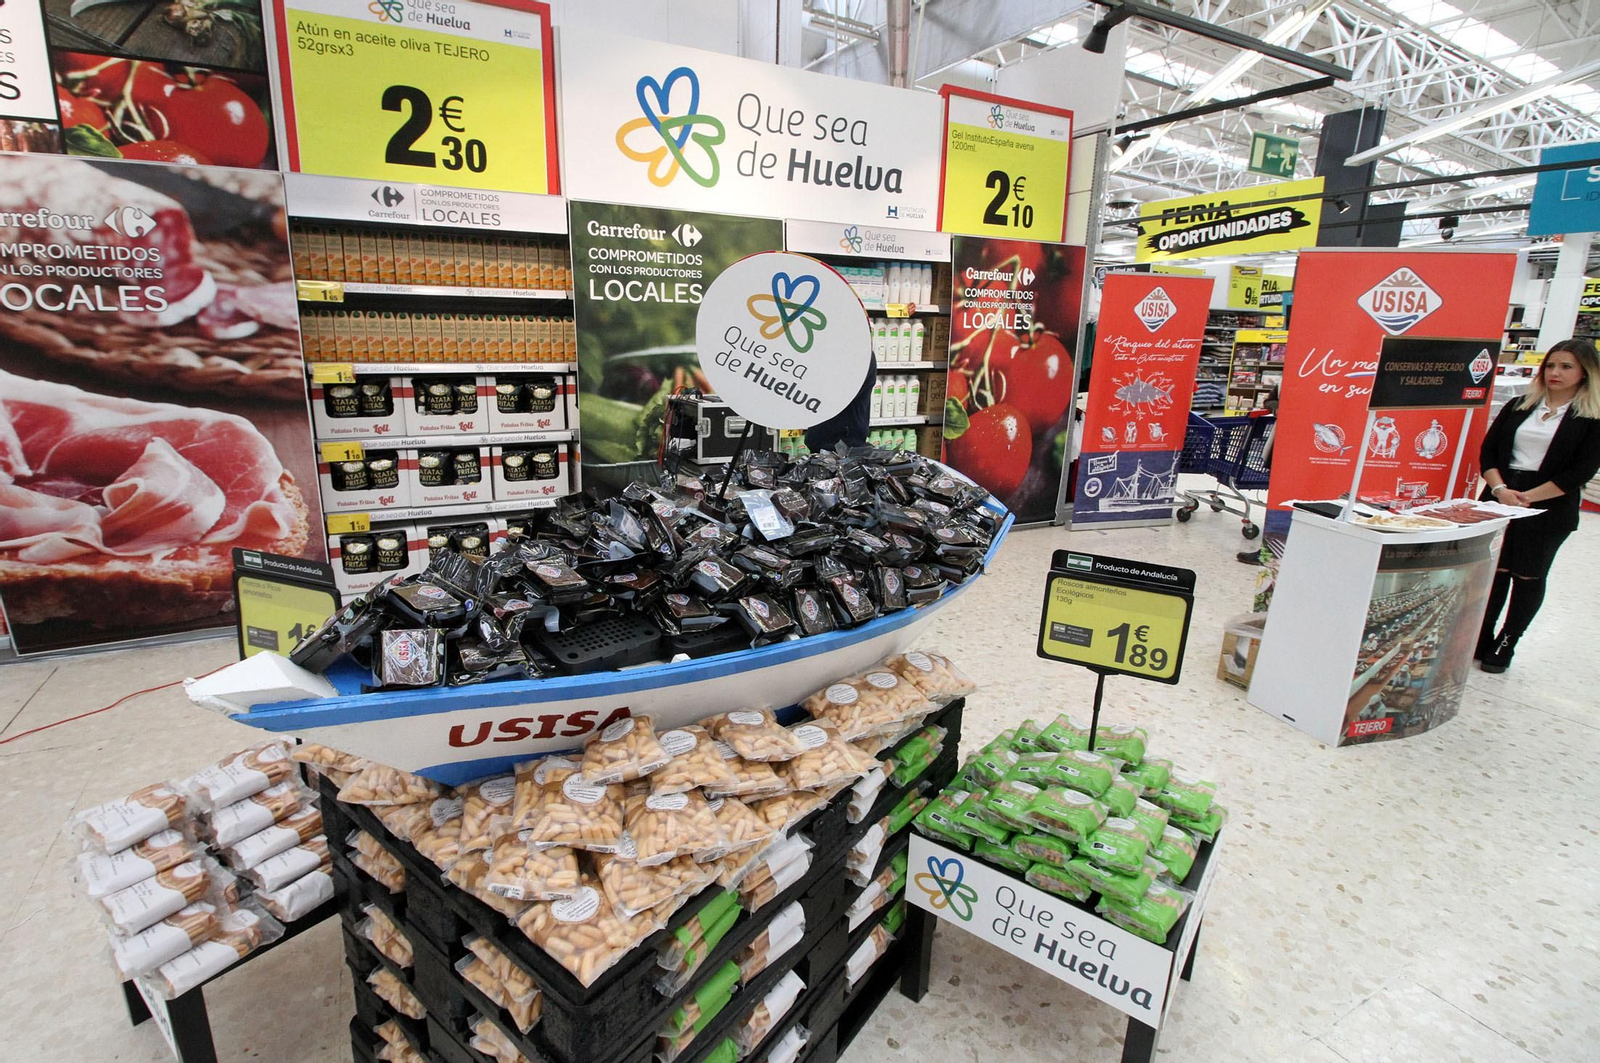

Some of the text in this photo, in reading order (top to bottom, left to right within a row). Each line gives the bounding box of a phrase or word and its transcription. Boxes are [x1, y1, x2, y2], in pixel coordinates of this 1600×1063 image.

[434, 1, 456, 14] sea
[407, 10, 471, 31] de Huelva
[296, 20, 490, 62] Atún en aceite oliva TEJERO
[297, 37, 354, 57] 52grsx3
[381, 84, 437, 169] 2
[441, 136, 487, 173] 30
[737, 93, 868, 147] Que sea
[1013, 121, 1035, 132] Huelva
[952, 130, 964, 140] Gel
[1015, 142, 1035, 151] avena
[737, 140, 903, 194] de Huelva
[368, 188, 500, 221] Carrefour COMPROMETIDOS
[983, 170, 1010, 226] 2
[1011, 204, 1034, 229] 10
[422, 208, 501, 227] LOCALES
[1161, 201, 1233, 227] FERIA
[587, 220, 667, 242] Carrefour
[864, 230, 896, 244] Que sea
[1159, 211, 1292, 251] OPORTUNIDADES
[588, 247, 703, 266] COMPROMETIDOS
[864, 242, 905, 254] de Huelva
[10, 265, 163, 279] LOS PRODUCTORES
[589, 264, 703, 279] CON LOS PRODUCTORES
[966, 267, 1014, 282] Carrefour
[385, 285, 413, 293] Huelva
[589, 279, 703, 305] LOCALES
[964, 287, 1034, 300] COMPROMETIDOS
[1261, 280, 1277, 291] RIA
[1244, 287, 1252, 305] 9
[1372, 290, 1428, 314] USISA
[978, 301, 991, 309] LOS
[991, 302, 1033, 311] PRODUCTORES
[1141, 301, 1170, 319] USISA
[963, 312, 1032, 330] LOCALES
[724, 325, 809, 380] Que sea
[1111, 336, 1153, 355] Ronqueo
[1155, 339, 1171, 349] del
[1299, 348, 1378, 378] Un ma
[1384, 359, 1489, 373] CONSERVAS DE PESCADO USISA
[714, 350, 822, 414] de Huelva
[1319, 382, 1343, 394] en
[1400, 376, 1444, 386] Y SALAZONES
[1465, 389, 1484, 399] TEJERO
[401, 438, 426, 446] Huelva
[344, 450, 350, 459] 1
[407, 509, 432, 517] Huelva
[349, 521, 355, 531] 1
[263, 559, 288, 569] Producto
[296, 565, 323, 576] Andalucía
[1096, 562, 1178, 581] Producto de Andalucía
[1056, 587, 1095, 600] Ecológicos
[1057, 578, 1127, 597] Roscos almonteños
[1056, 595, 1073, 605] 130g
[1107, 622, 1131, 664] 1
[1129, 644, 1168, 671] 89
[1354, 720, 1387, 734] TEJERO
[995, 885, 1117, 961] Que sea
[992, 916, 1153, 1010] de Huelva
